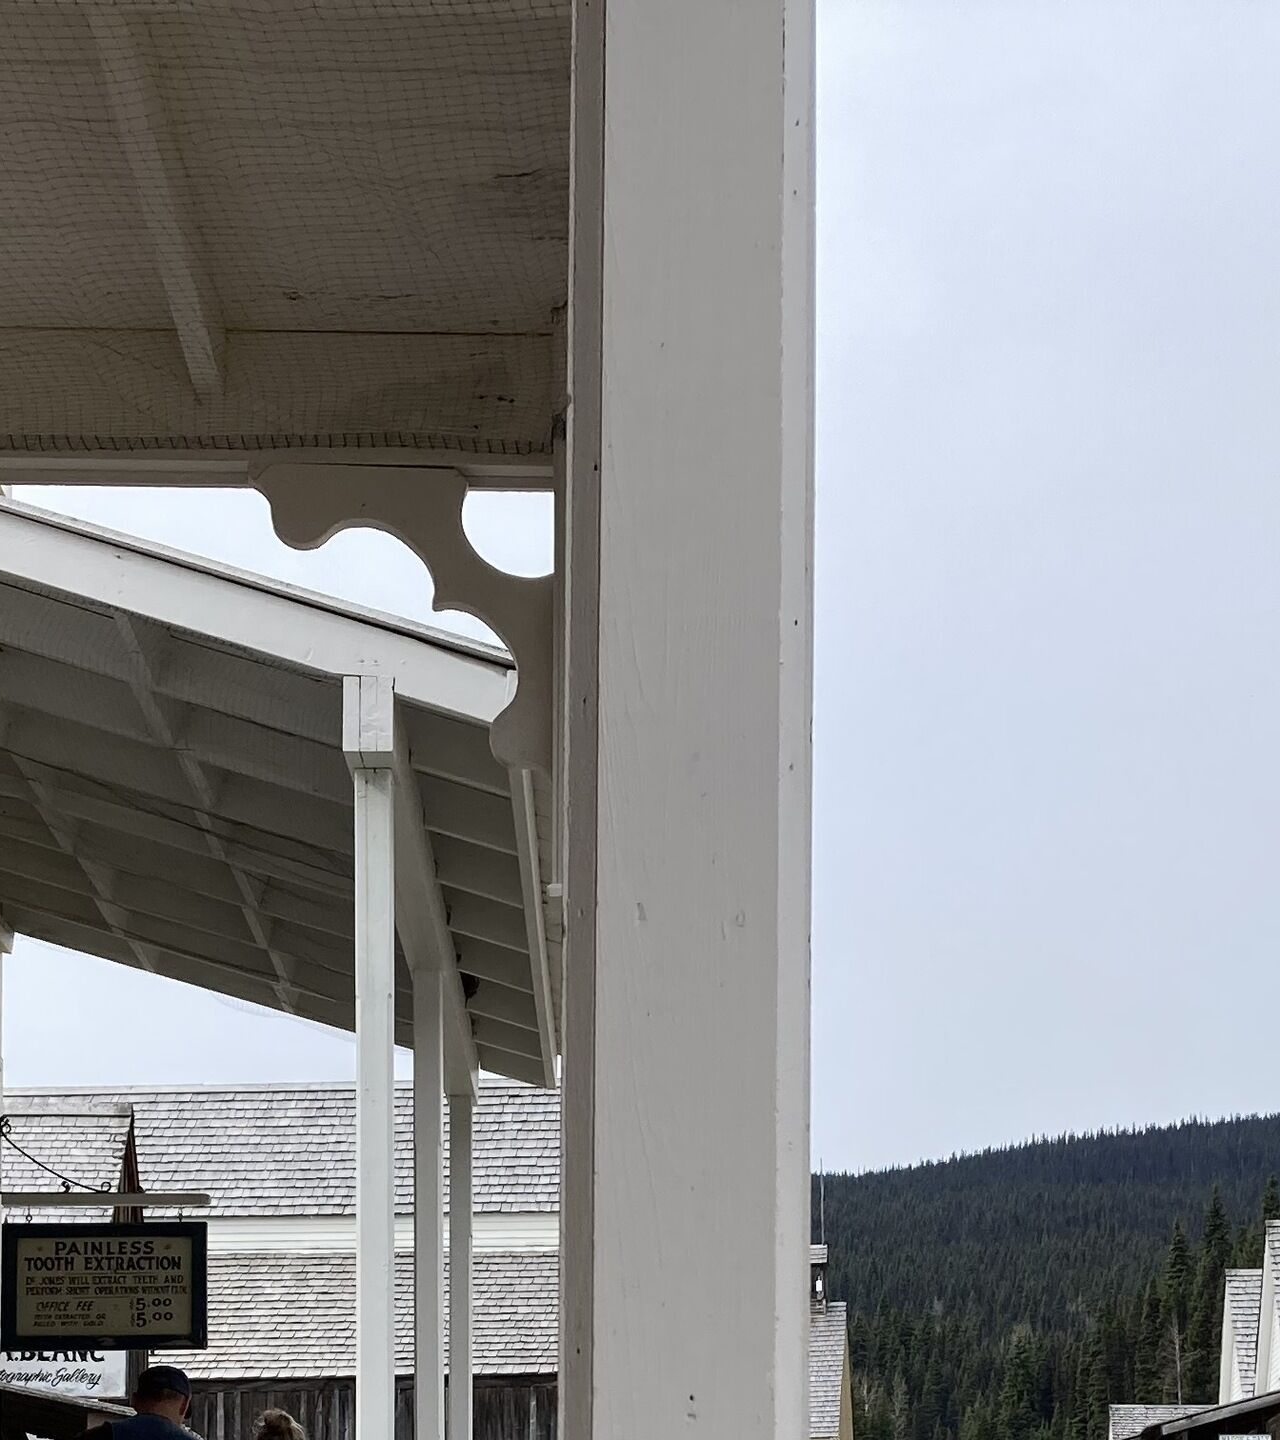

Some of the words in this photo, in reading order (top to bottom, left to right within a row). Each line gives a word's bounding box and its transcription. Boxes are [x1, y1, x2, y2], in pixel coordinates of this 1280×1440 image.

[54, 1241, 155, 1255] PAINLESS
[24, 1256, 75, 1271] TOOTH
[84, 1256, 182, 1271] EXTRACTION
[68, 1276, 90, 1285] WILL
[92, 1276, 127, 1285] EXTRACT
[133, 1275, 159, 1284] TEETH
[163, 1275, 184, 1284] AND
[25, 1287, 62, 1296] PERFORM
[66, 1287, 91, 1296] SHORT
[94, 1286, 139, 1296] OPERATIONS
[36, 1301, 69, 1312] OFFICE
[76, 1300, 95, 1311] FEE
[51, 1367, 102, 1390] Gallery
